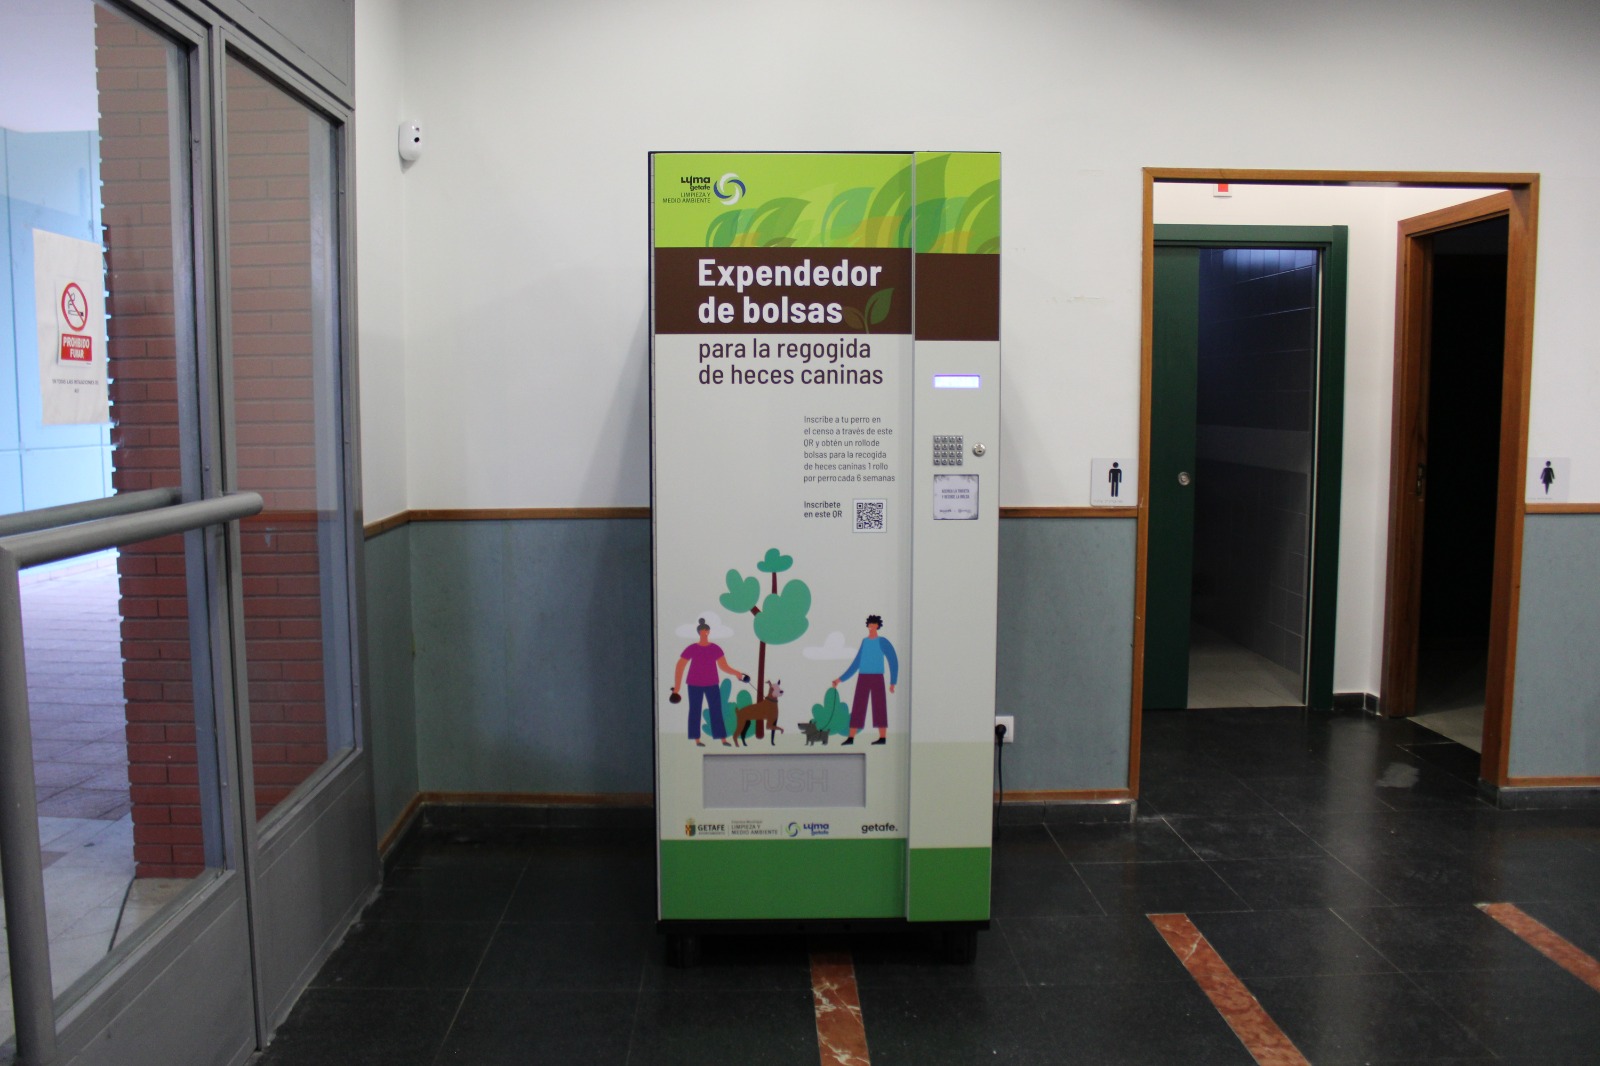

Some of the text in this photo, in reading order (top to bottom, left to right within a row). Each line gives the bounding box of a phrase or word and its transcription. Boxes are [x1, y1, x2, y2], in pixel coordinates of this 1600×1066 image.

[698, 258, 882, 293] Expendedor
[698, 296, 843, 324] de bolsas
[63, 336, 90, 349] PROHIBIDO
[699, 338, 871, 363] para la regogida
[698, 364, 883, 385] de heces caninas
[804, 416, 833, 424] Inscribe
[841, 416, 849, 424] tu
[842, 427, 865, 435] través
[803, 439, 814, 447] QR
[821, 439, 843, 447] obtén
[804, 451, 887, 460] bolsas para la recogida
[814, 510, 831, 518] este
[832, 510, 843, 519] QR
[741, 767, 829, 793] PUSH
